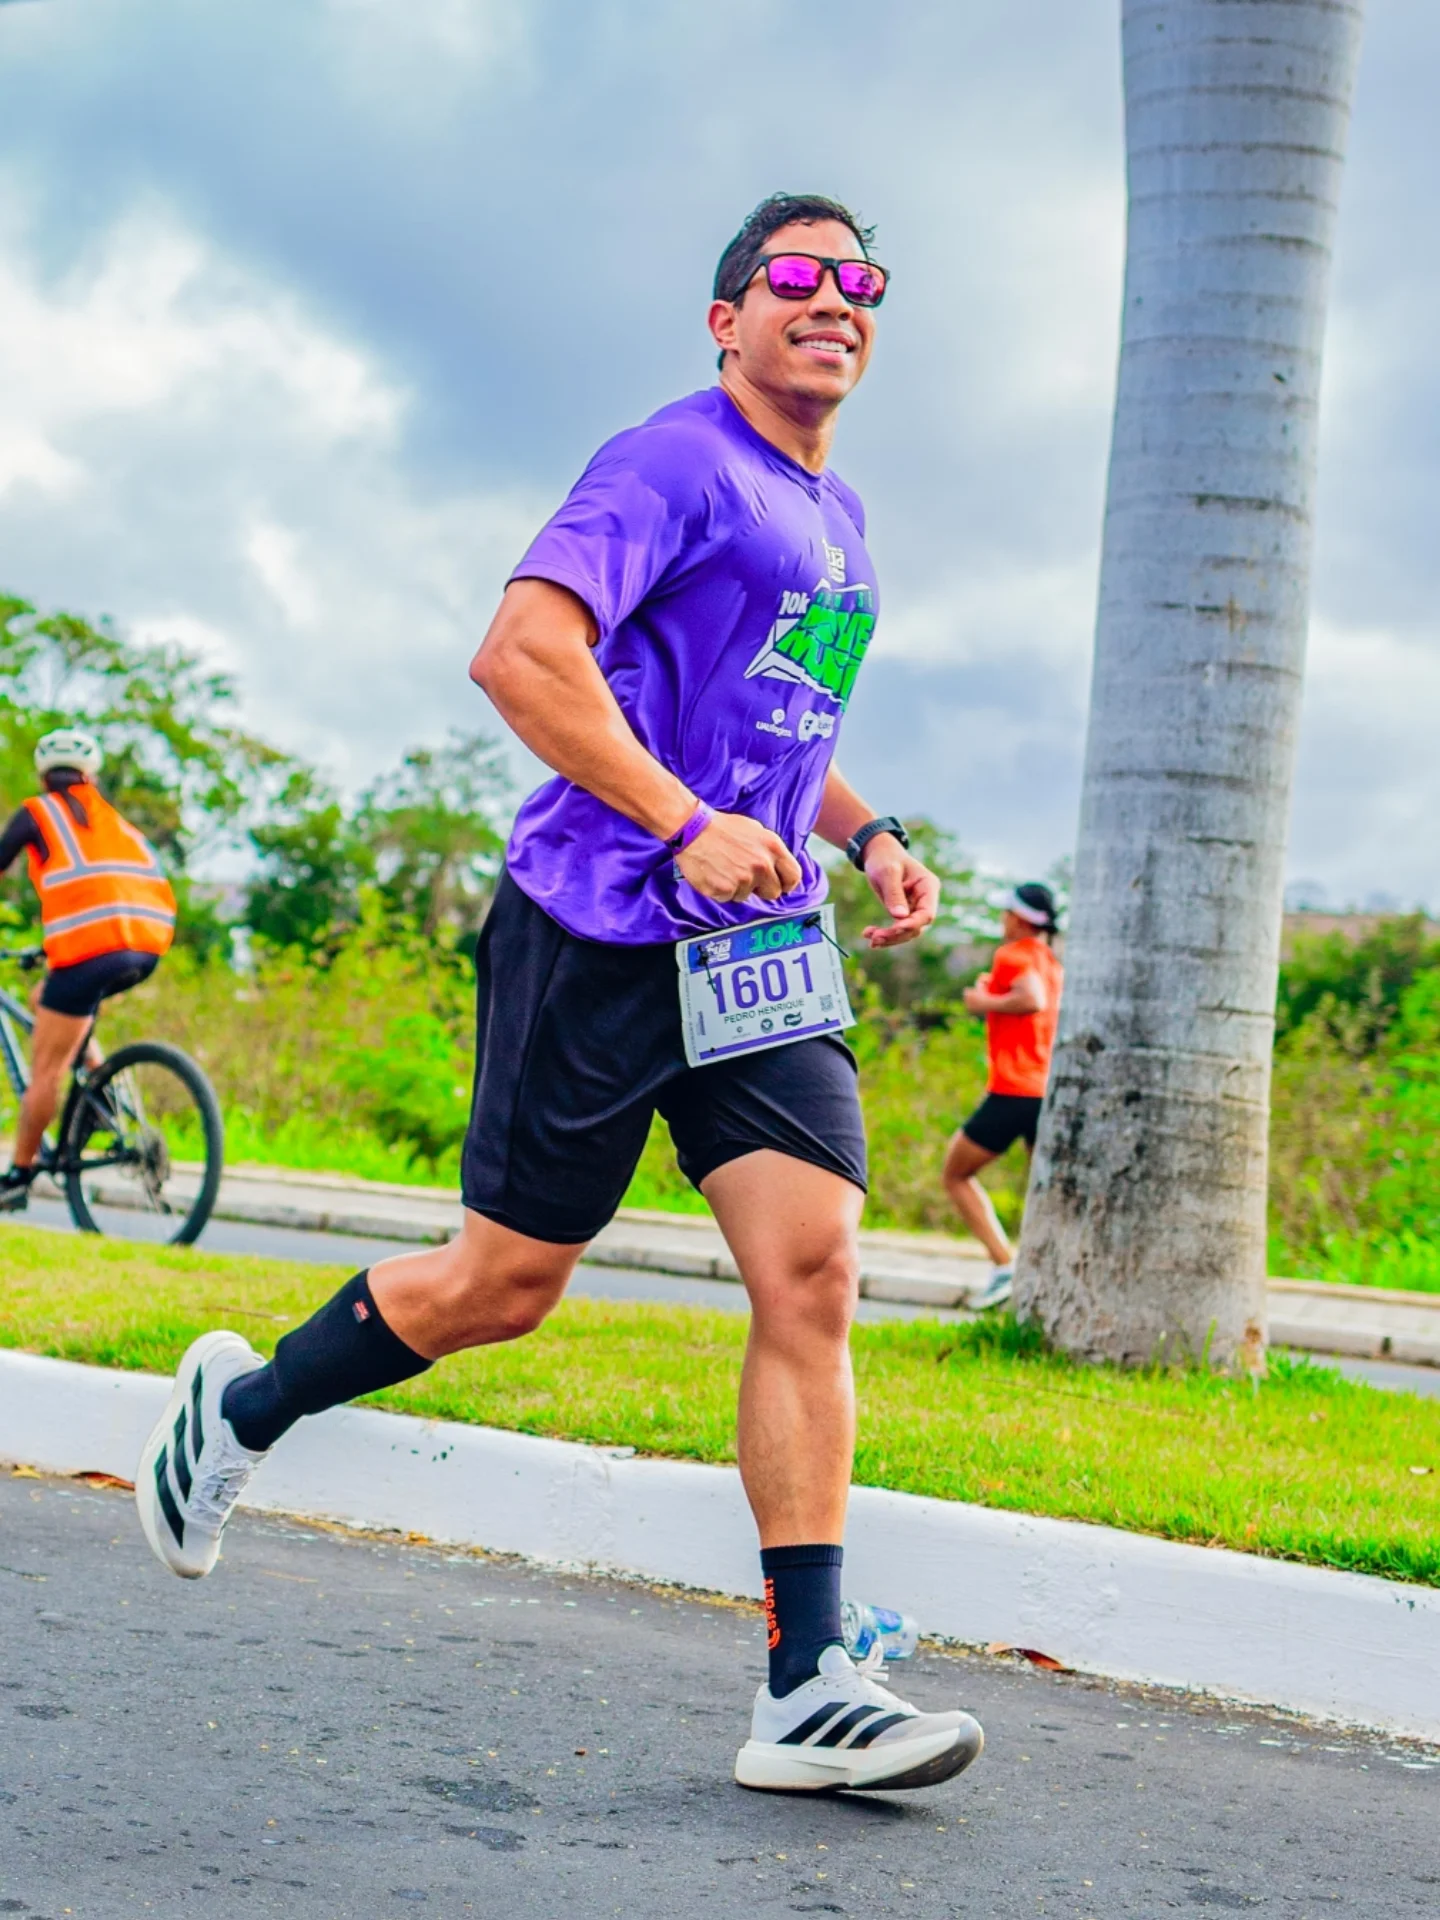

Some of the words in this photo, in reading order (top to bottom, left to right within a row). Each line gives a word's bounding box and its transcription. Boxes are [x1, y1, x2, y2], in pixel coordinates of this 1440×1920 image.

[711, 952, 814, 1015] 1601
[723, 1010, 756, 1025] PEDRO
[758, 998, 805, 1016] HENRIQUE
[763, 1577, 777, 1630] SPORT
